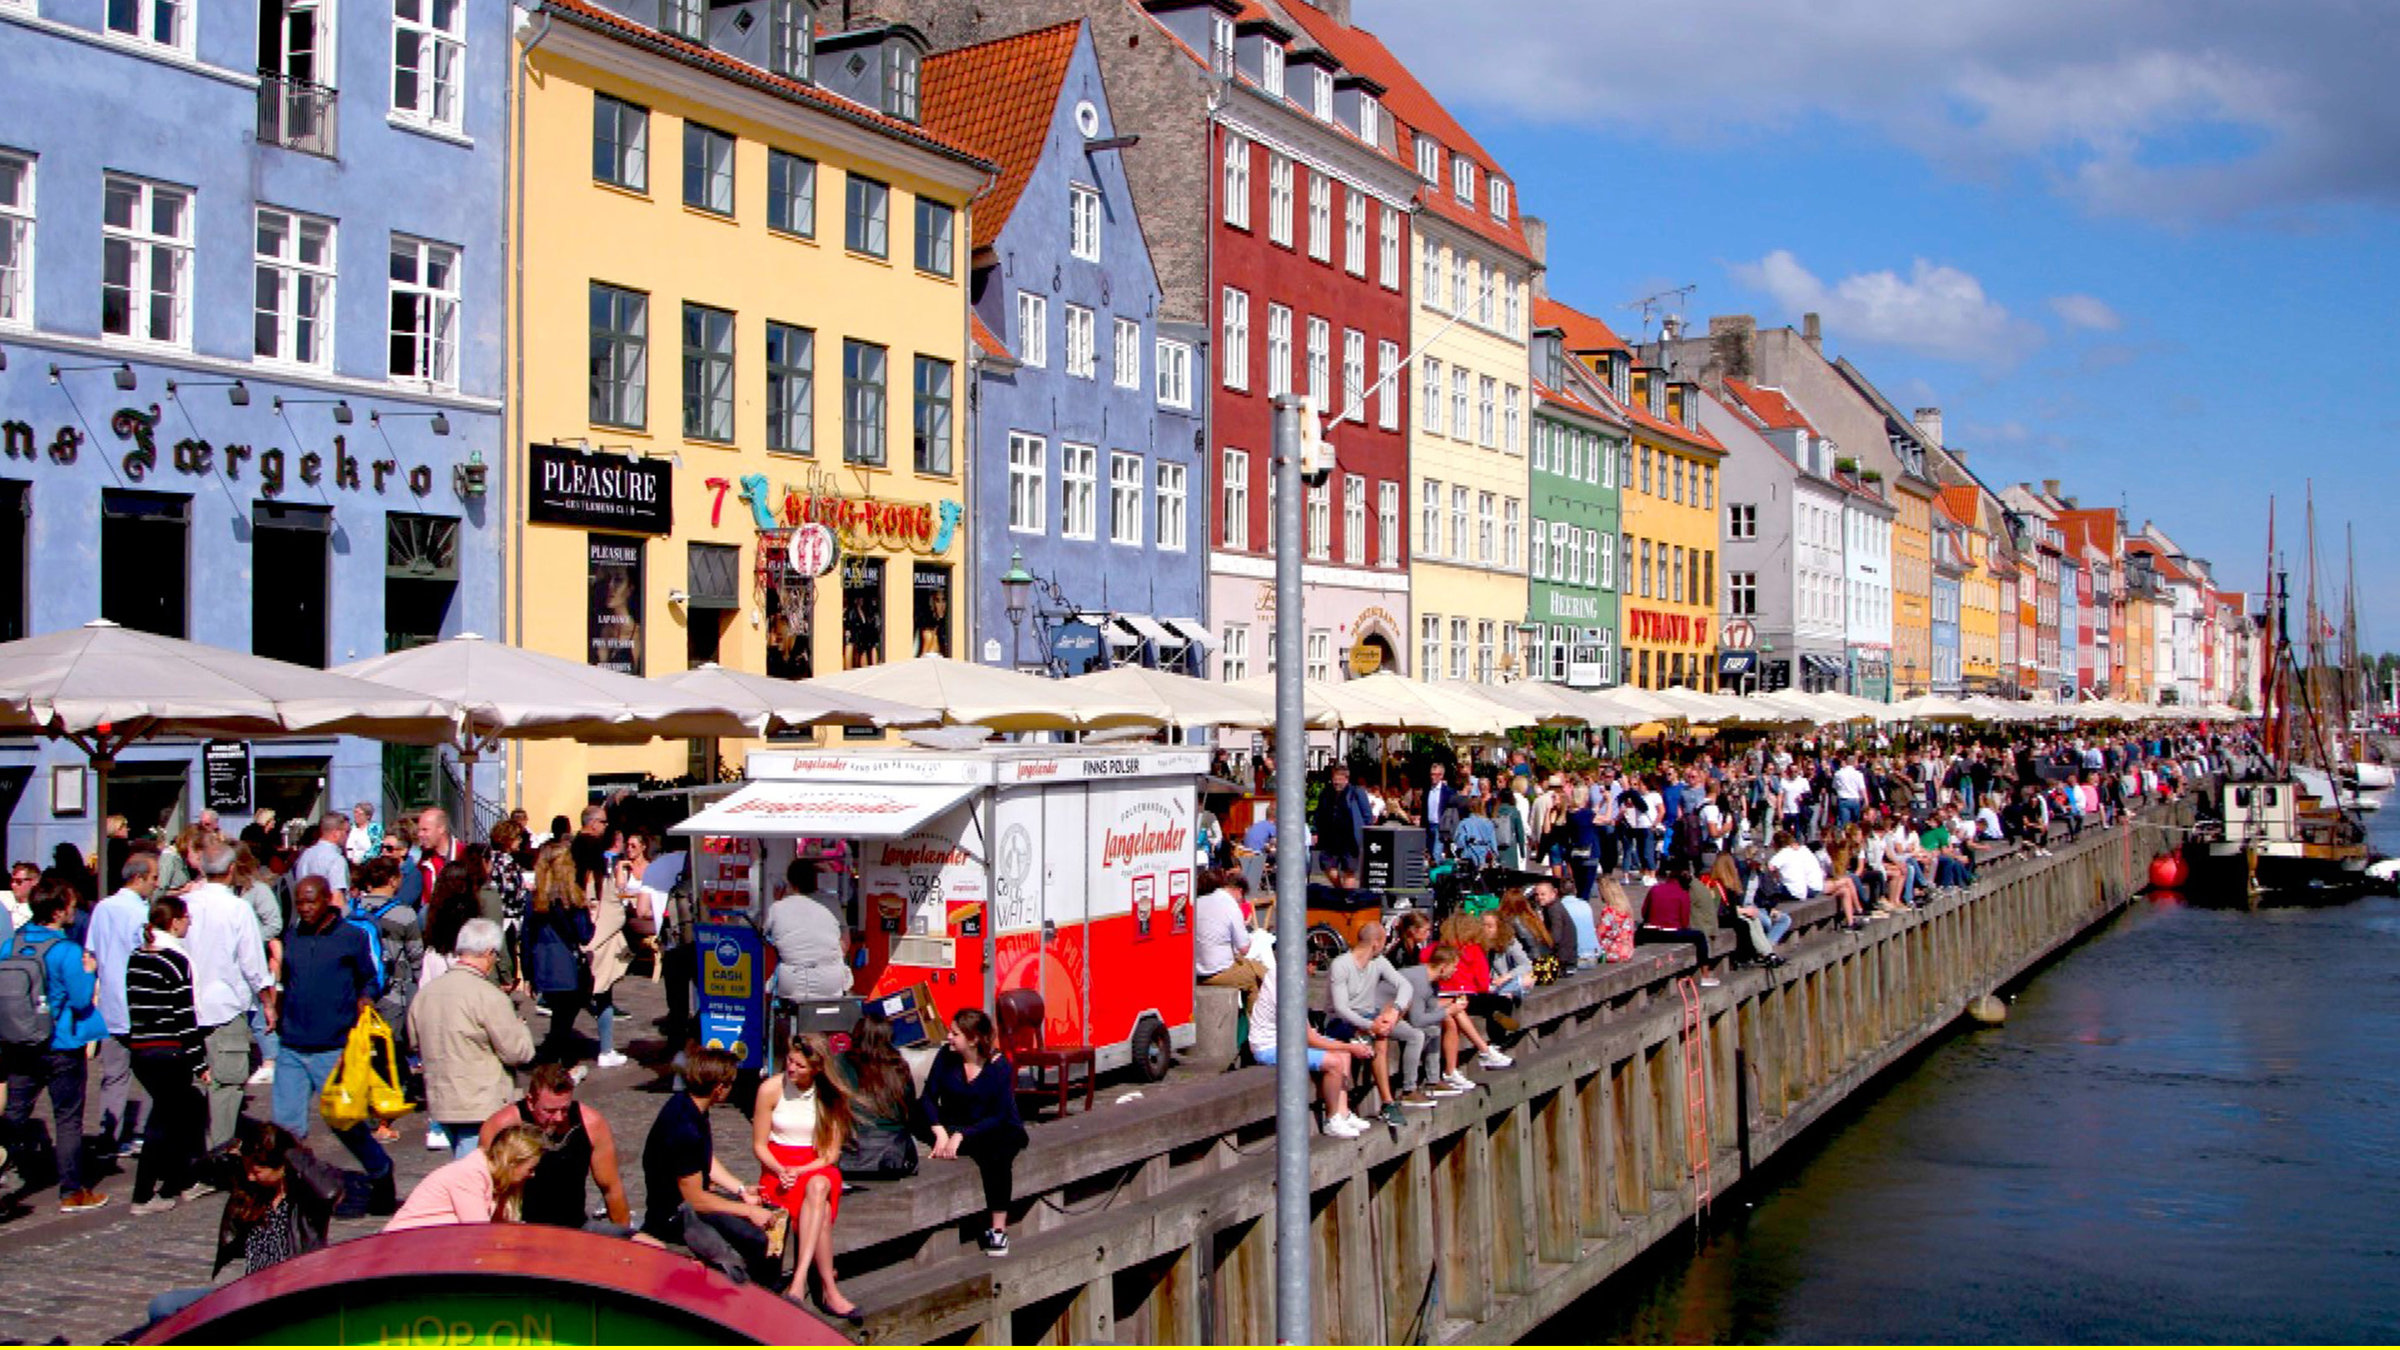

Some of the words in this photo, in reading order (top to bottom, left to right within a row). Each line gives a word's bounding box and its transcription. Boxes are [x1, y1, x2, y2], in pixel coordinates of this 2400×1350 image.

[544, 460, 657, 504] PLEASURE
[705, 477, 731, 528] 7
[591, 545, 637, 561] PLEASURE
[1550, 590, 1598, 618] HEERING
[1630, 608, 1690, 645] NYHAVN
[1694, 616, 1708, 647] 17
[1724, 624, 1749, 649] 17
[1083, 760, 1108, 777] FINNS
[712, 970, 743, 981] CASH
[380, 1315, 475, 1346] HOP
[485, 1312, 554, 1346] ON
